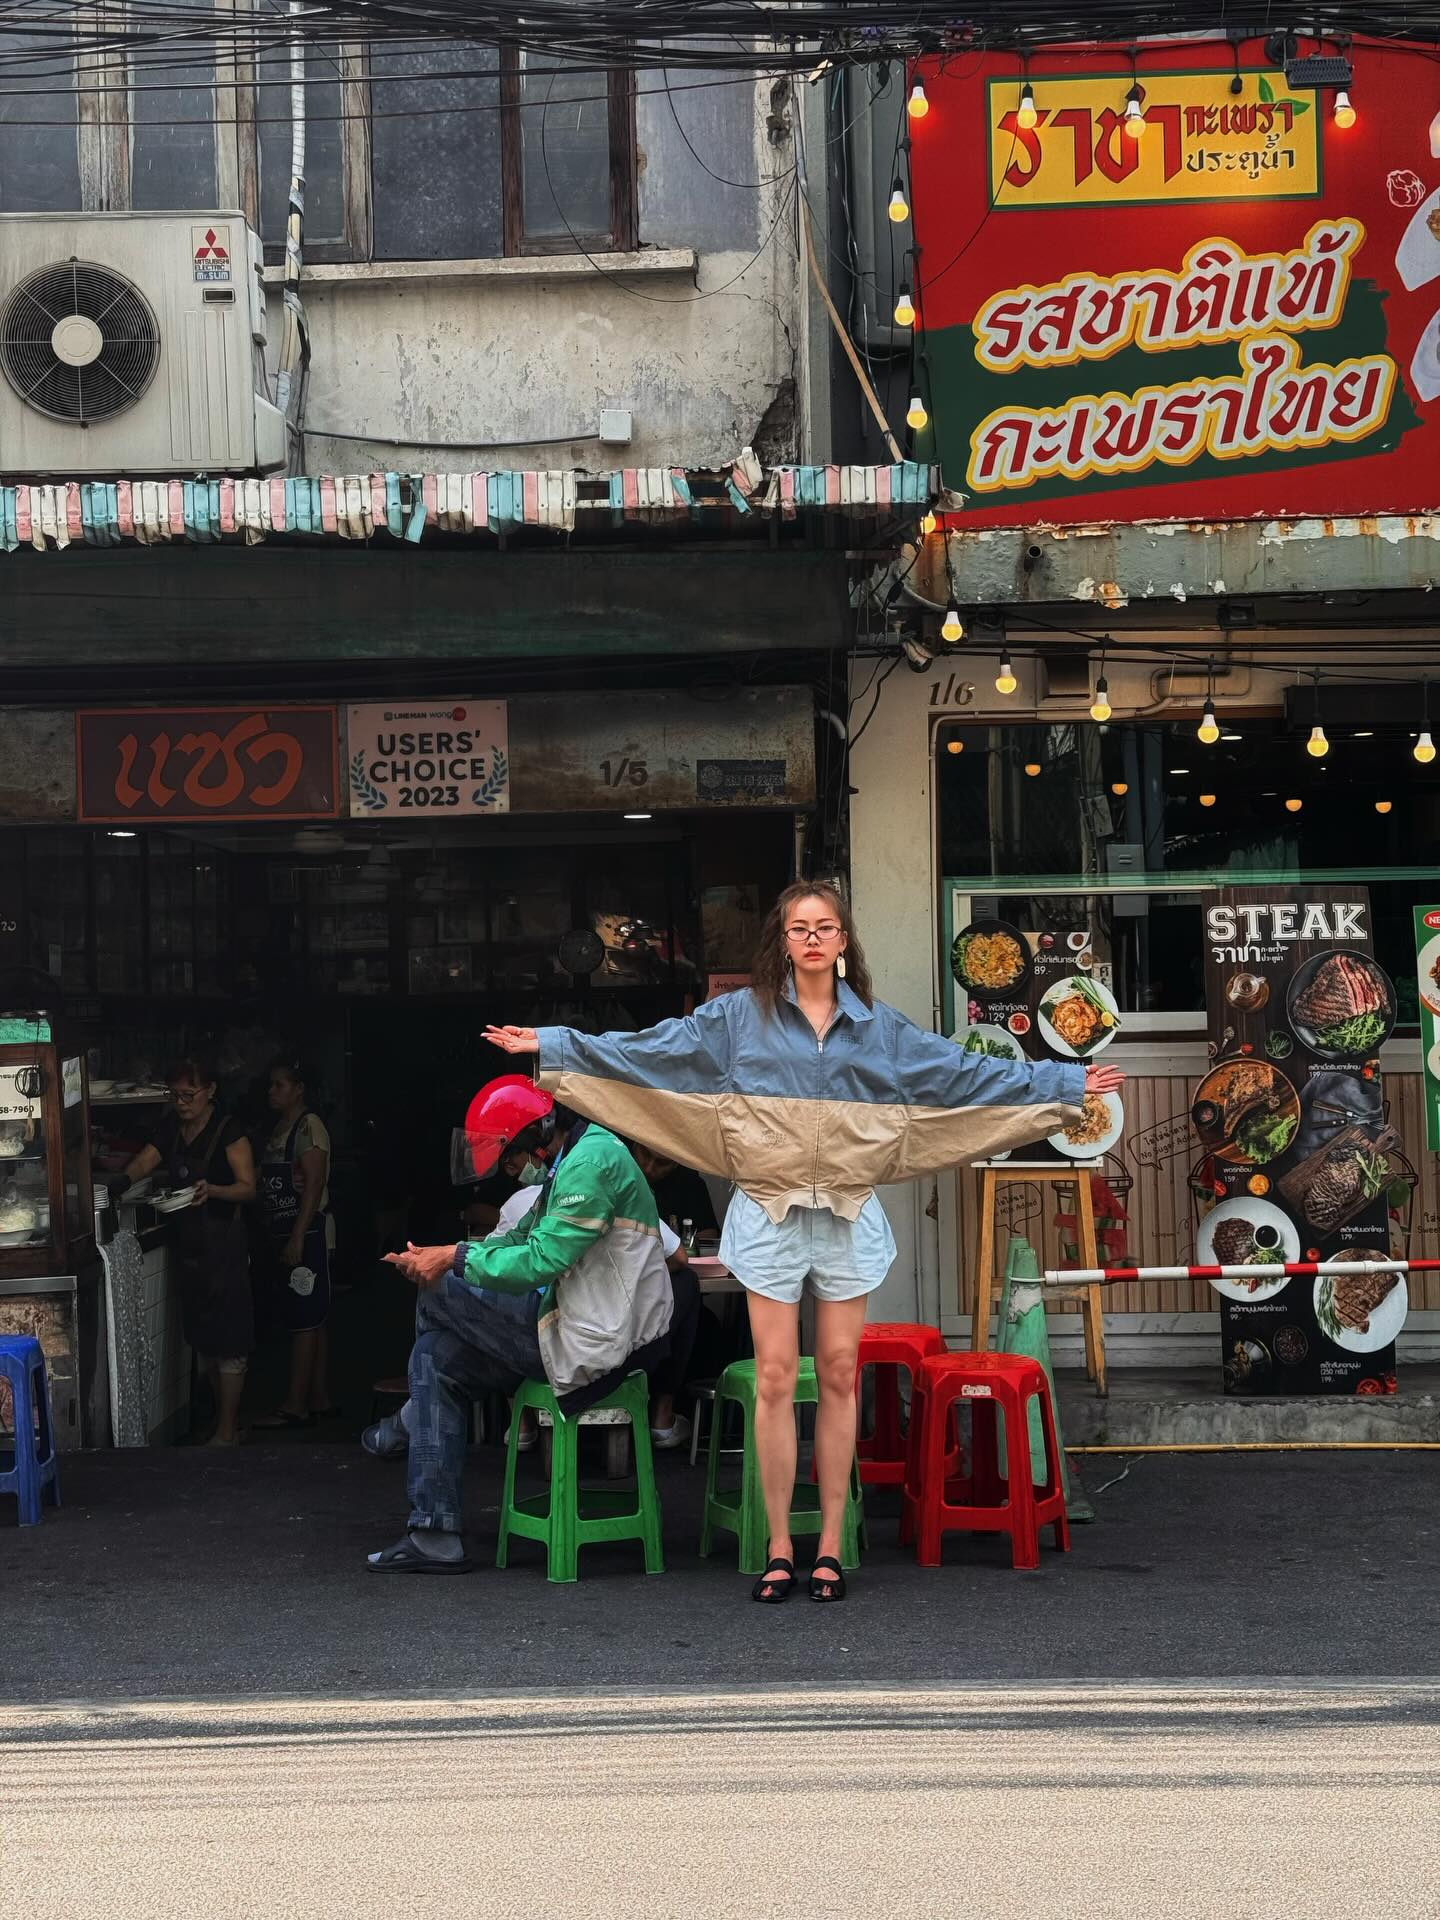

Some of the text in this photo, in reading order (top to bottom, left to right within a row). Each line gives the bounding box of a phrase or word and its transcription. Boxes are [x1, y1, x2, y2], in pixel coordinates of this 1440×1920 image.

[1183, 102, 1293, 137] กะเพรา
[1187, 133, 1295, 180] ประตูน้ำ
[982, 222, 1360, 365] รสชาติแท้
[974, 339, 1389, 483] กะเพราไทย
[929, 672, 975, 706] 1/6
[369, 758, 486, 783] CHOICE
[600, 758, 649, 787] 1/5
[398, 786, 460, 807] 2023
[1207, 903, 1368, 942] STEAK
[1211, 940, 1261, 963] ราชา
[1034, 965, 1052, 975] 89.-
